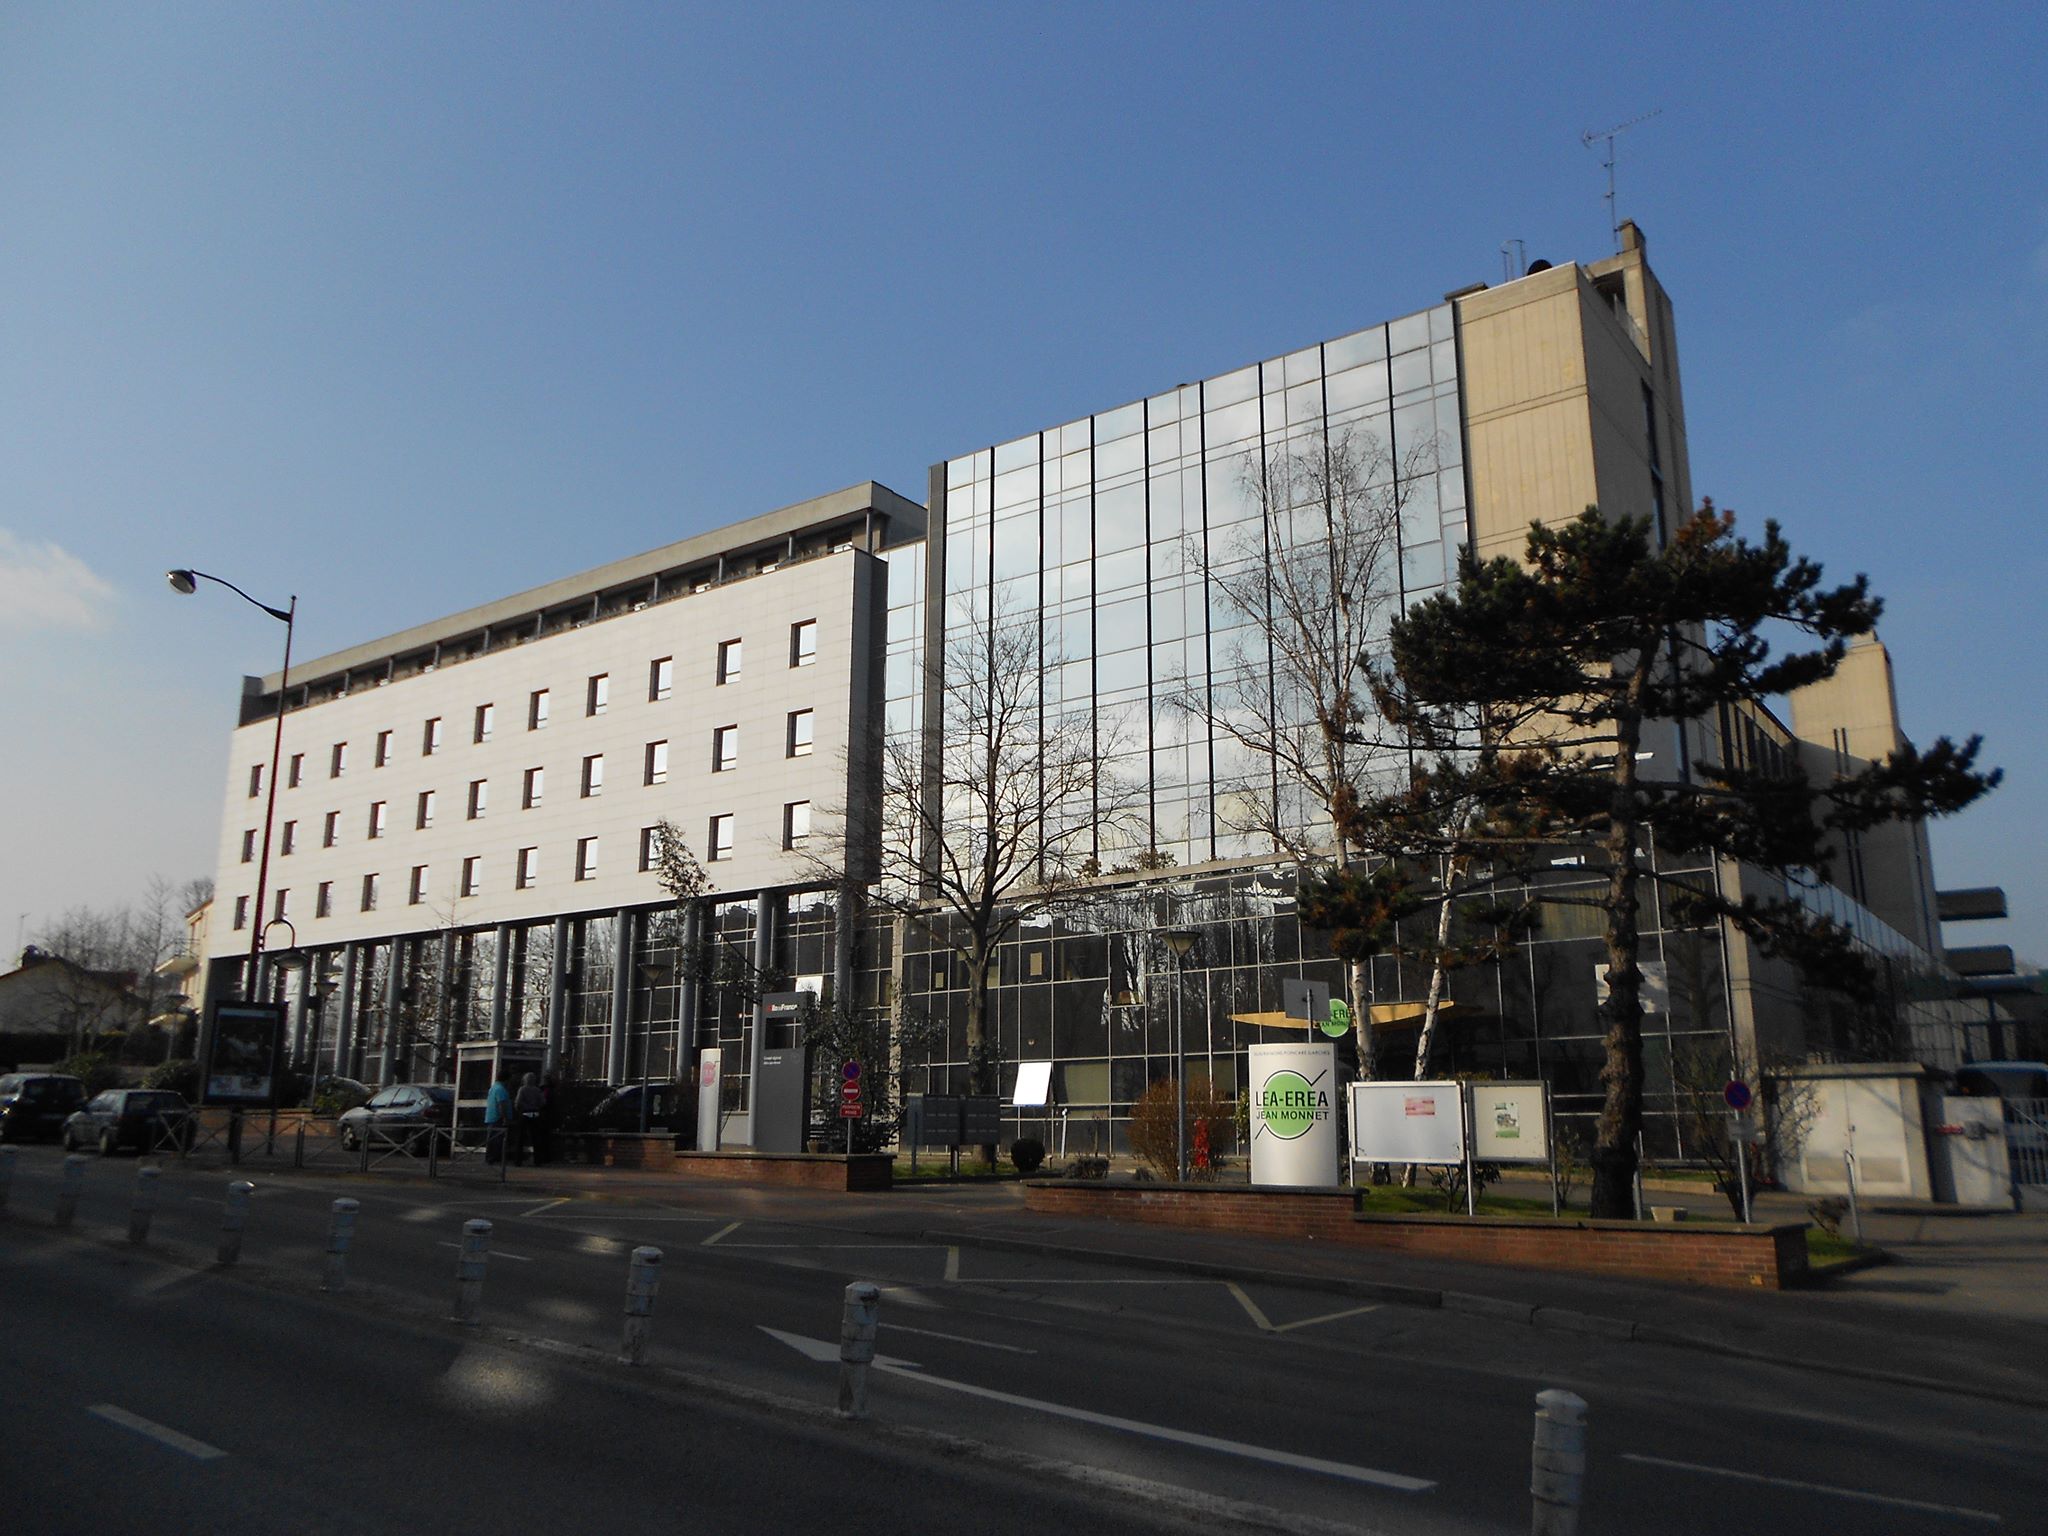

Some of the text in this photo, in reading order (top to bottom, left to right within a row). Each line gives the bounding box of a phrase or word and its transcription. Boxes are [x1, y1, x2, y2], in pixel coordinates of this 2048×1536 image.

[1255, 1091, 1329, 1107] LEA-EREA
[1256, 1111, 1329, 1121] JEAN MONNET
